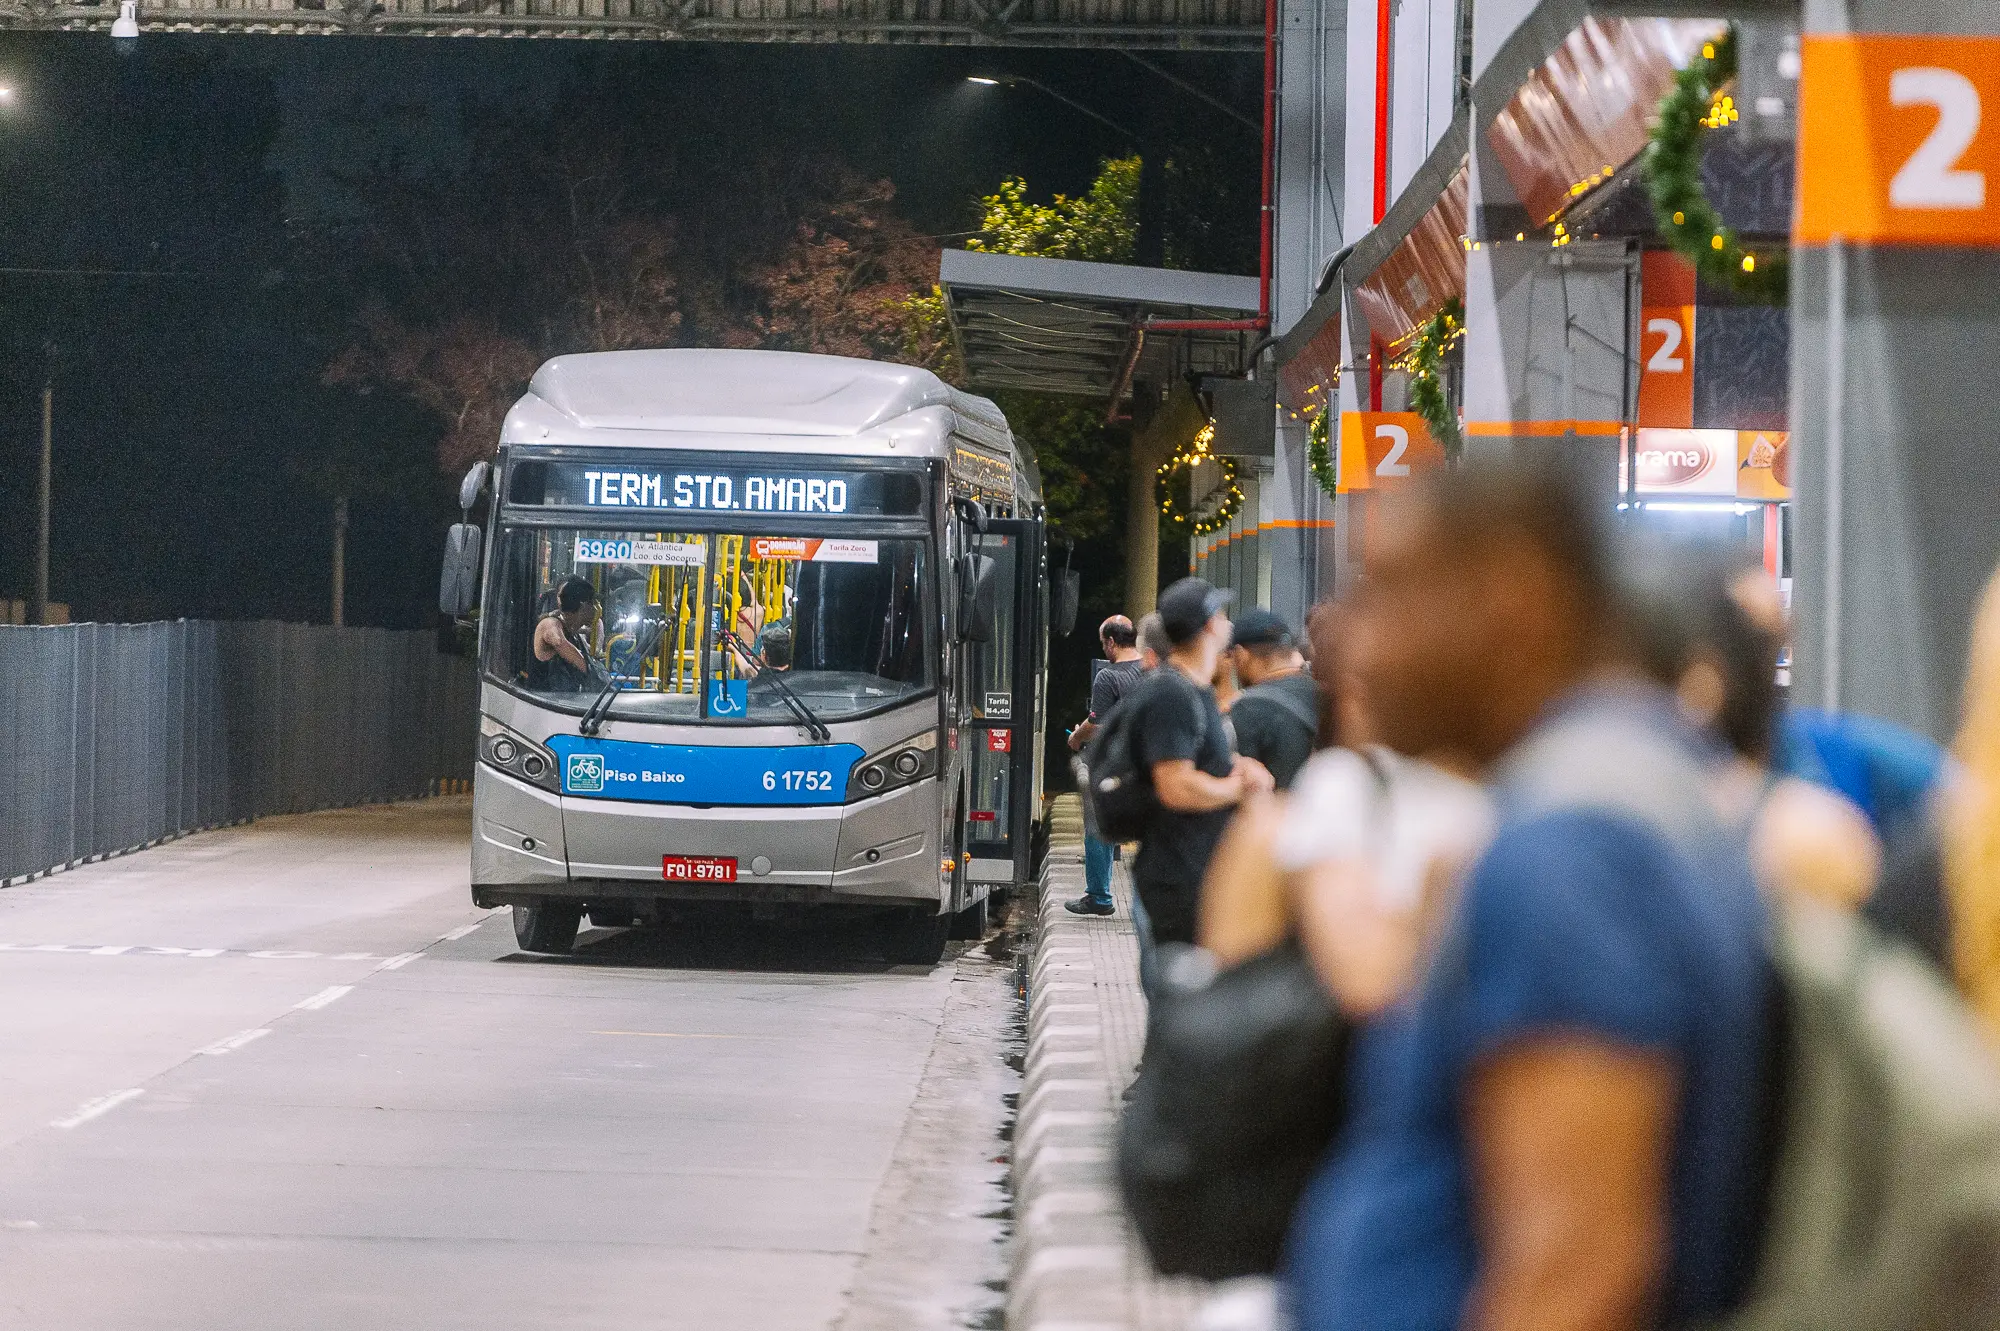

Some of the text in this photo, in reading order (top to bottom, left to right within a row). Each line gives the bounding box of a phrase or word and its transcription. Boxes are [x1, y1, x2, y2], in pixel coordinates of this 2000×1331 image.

[1889, 66, 1986, 210] 2
[1647, 318, 1685, 373] 2
[1375, 424, 1411, 477] 2
[578, 540, 631, 560] 6960
[829, 544, 849, 552] Tarifa
[604, 769, 686, 783] Piso Baixo
[762, 770, 833, 792] 6 1752
